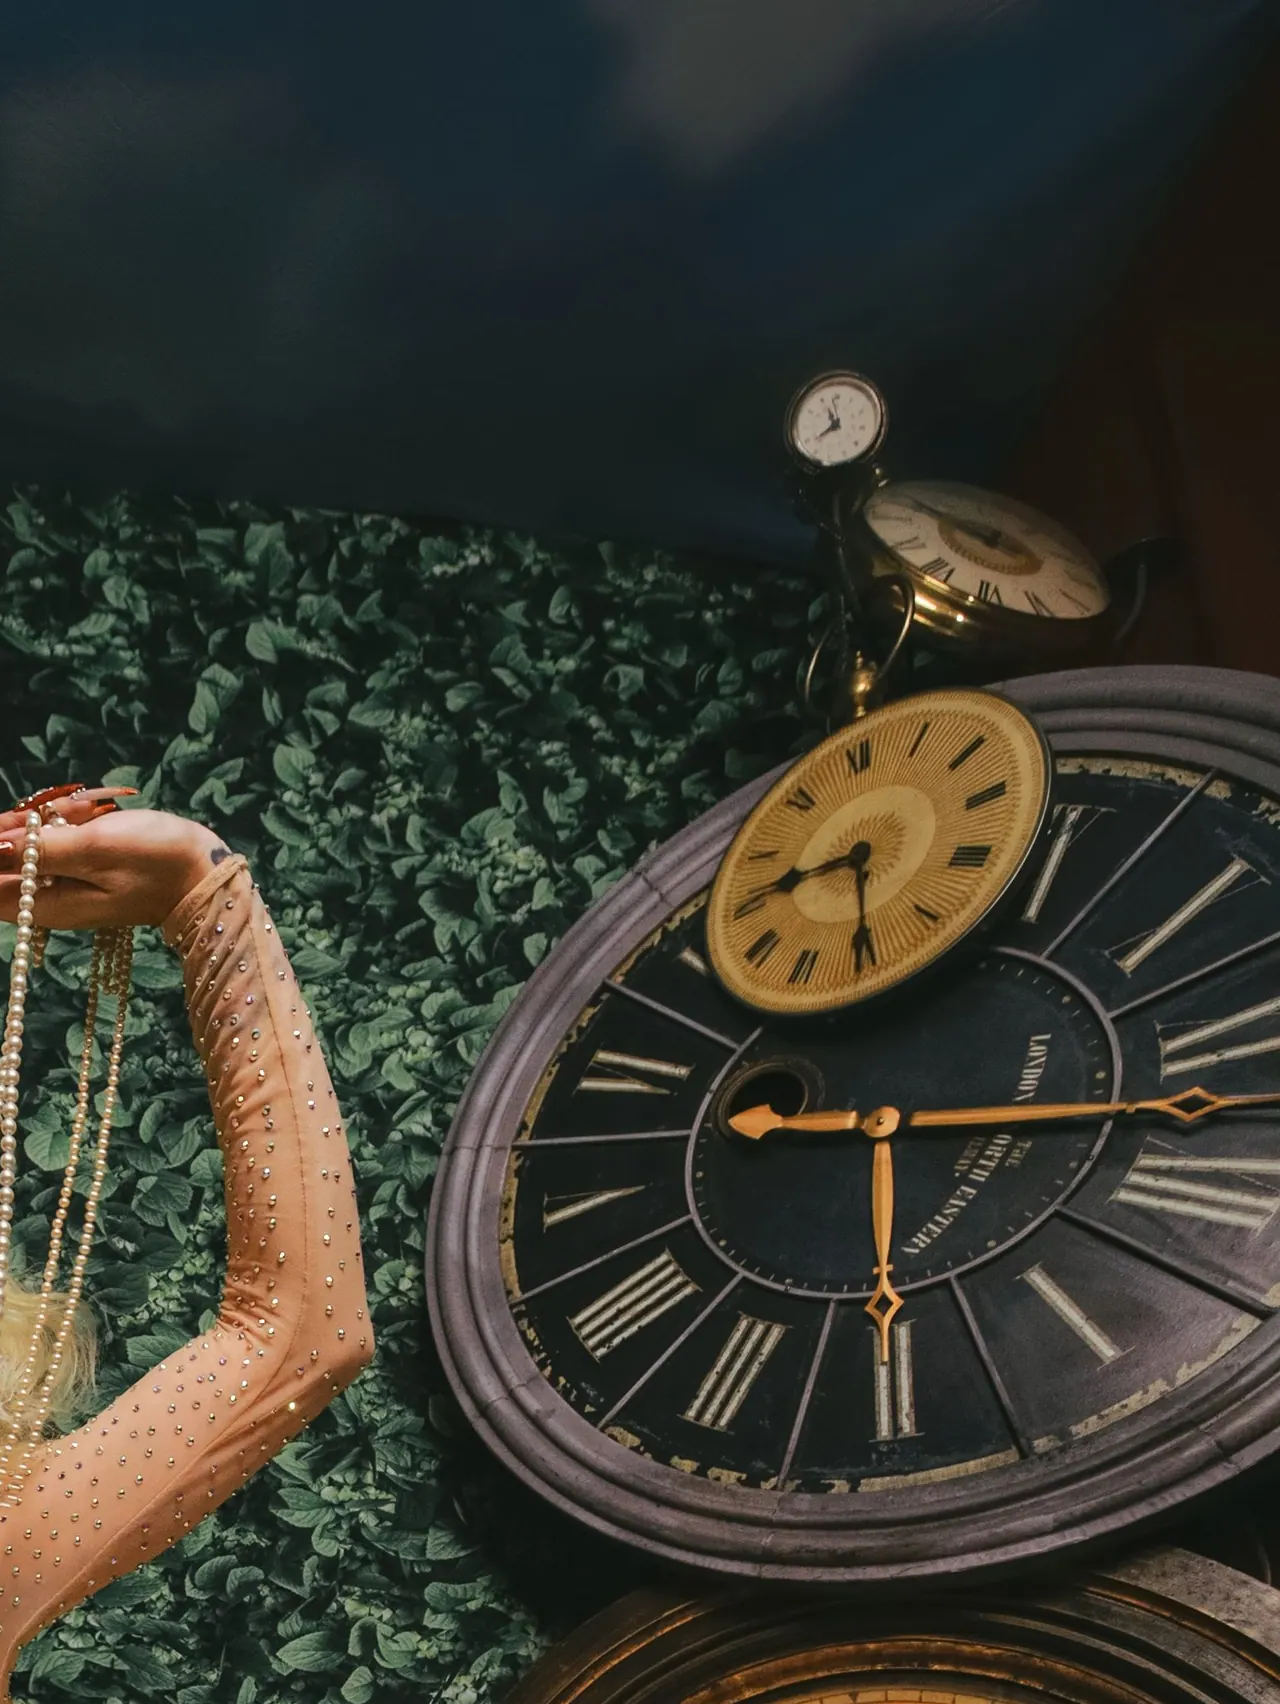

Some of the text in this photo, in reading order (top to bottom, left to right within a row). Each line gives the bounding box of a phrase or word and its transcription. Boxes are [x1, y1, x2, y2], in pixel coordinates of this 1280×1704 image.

[900, 1033, 1052, 1257] LONDON ORTH EASTERN
[566, 1246, 703, 1363] IIII
[1016, 1261, 1135, 1371] I
[676, 1310, 794, 1435] III
